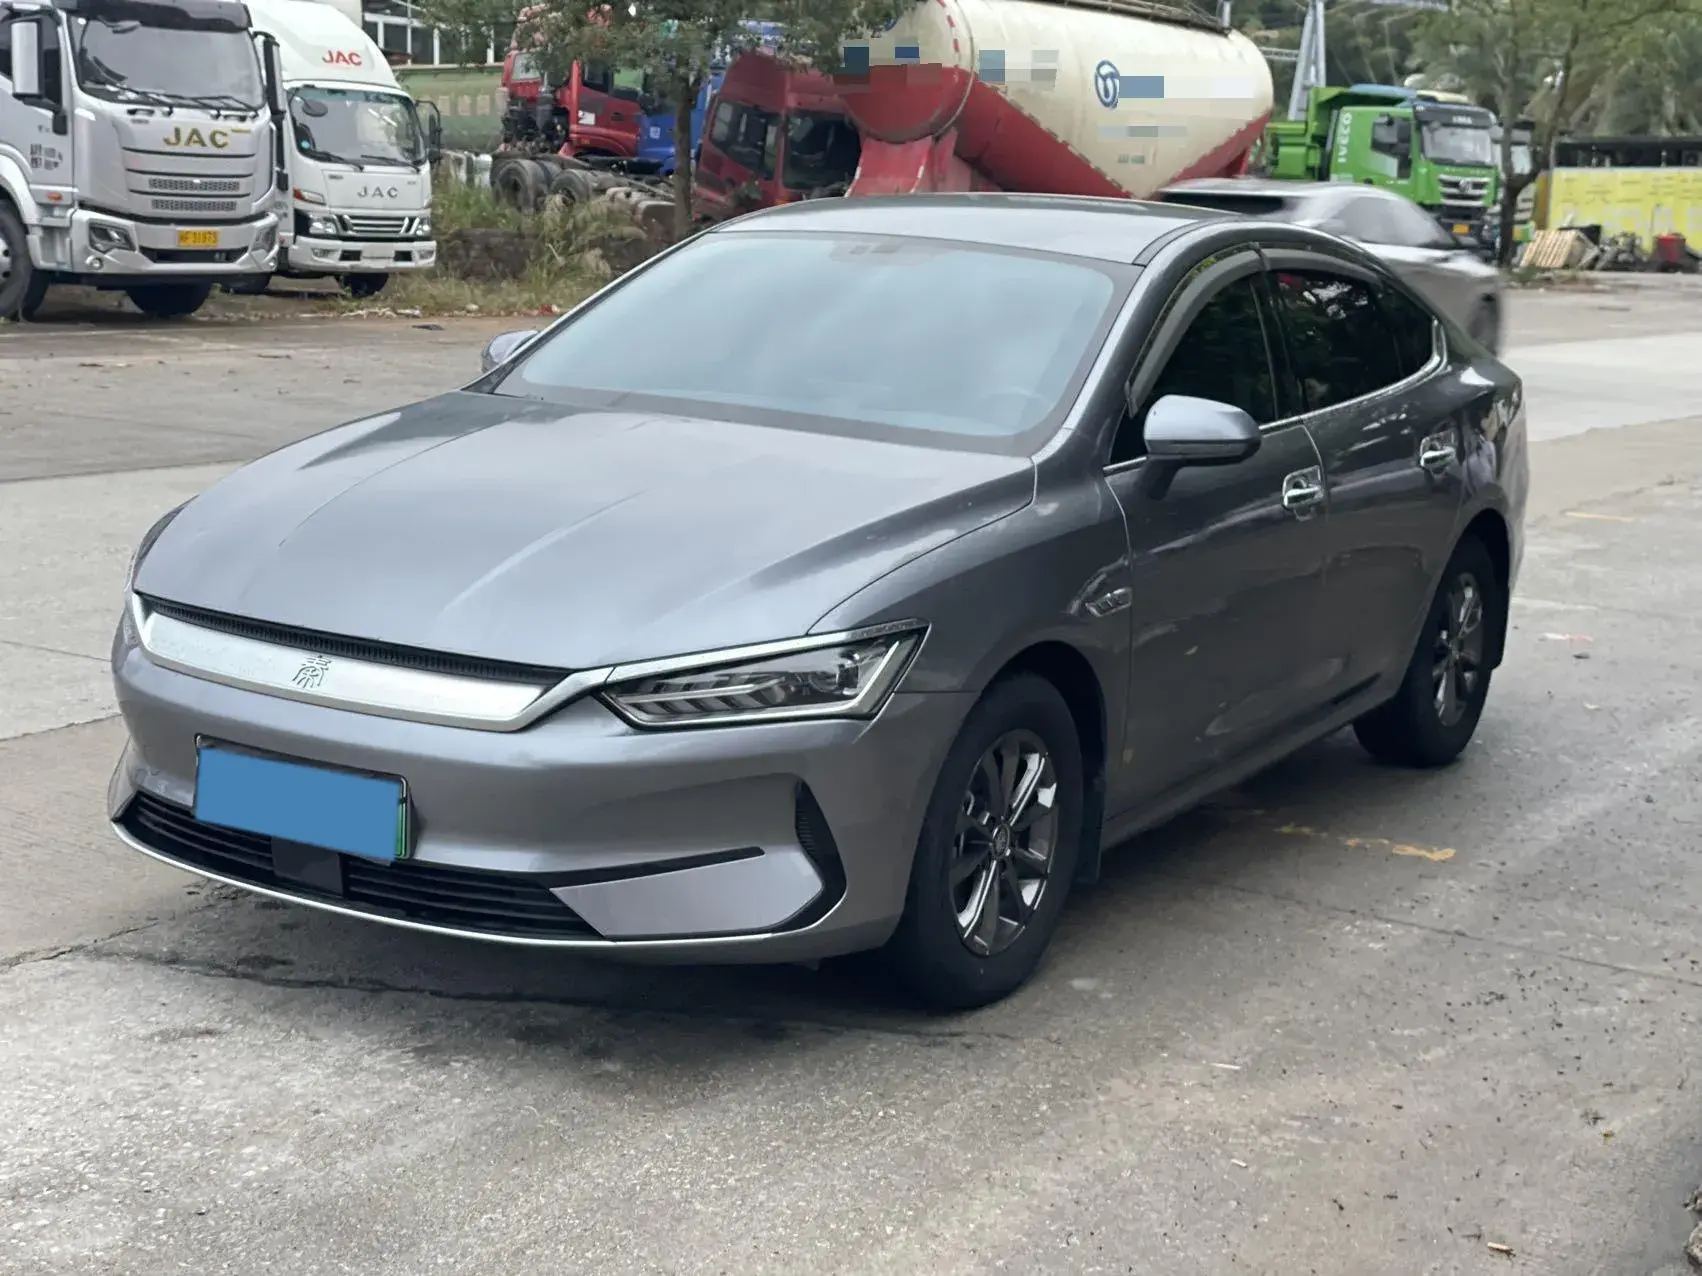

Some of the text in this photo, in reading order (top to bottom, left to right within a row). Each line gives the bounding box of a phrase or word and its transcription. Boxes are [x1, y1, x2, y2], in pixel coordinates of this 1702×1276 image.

[322, 50, 362, 66] JAC
[163, 127, 229, 149] JAC
[1337, 112, 1353, 163] IVECO
[357, 186, 398, 198] JAC
